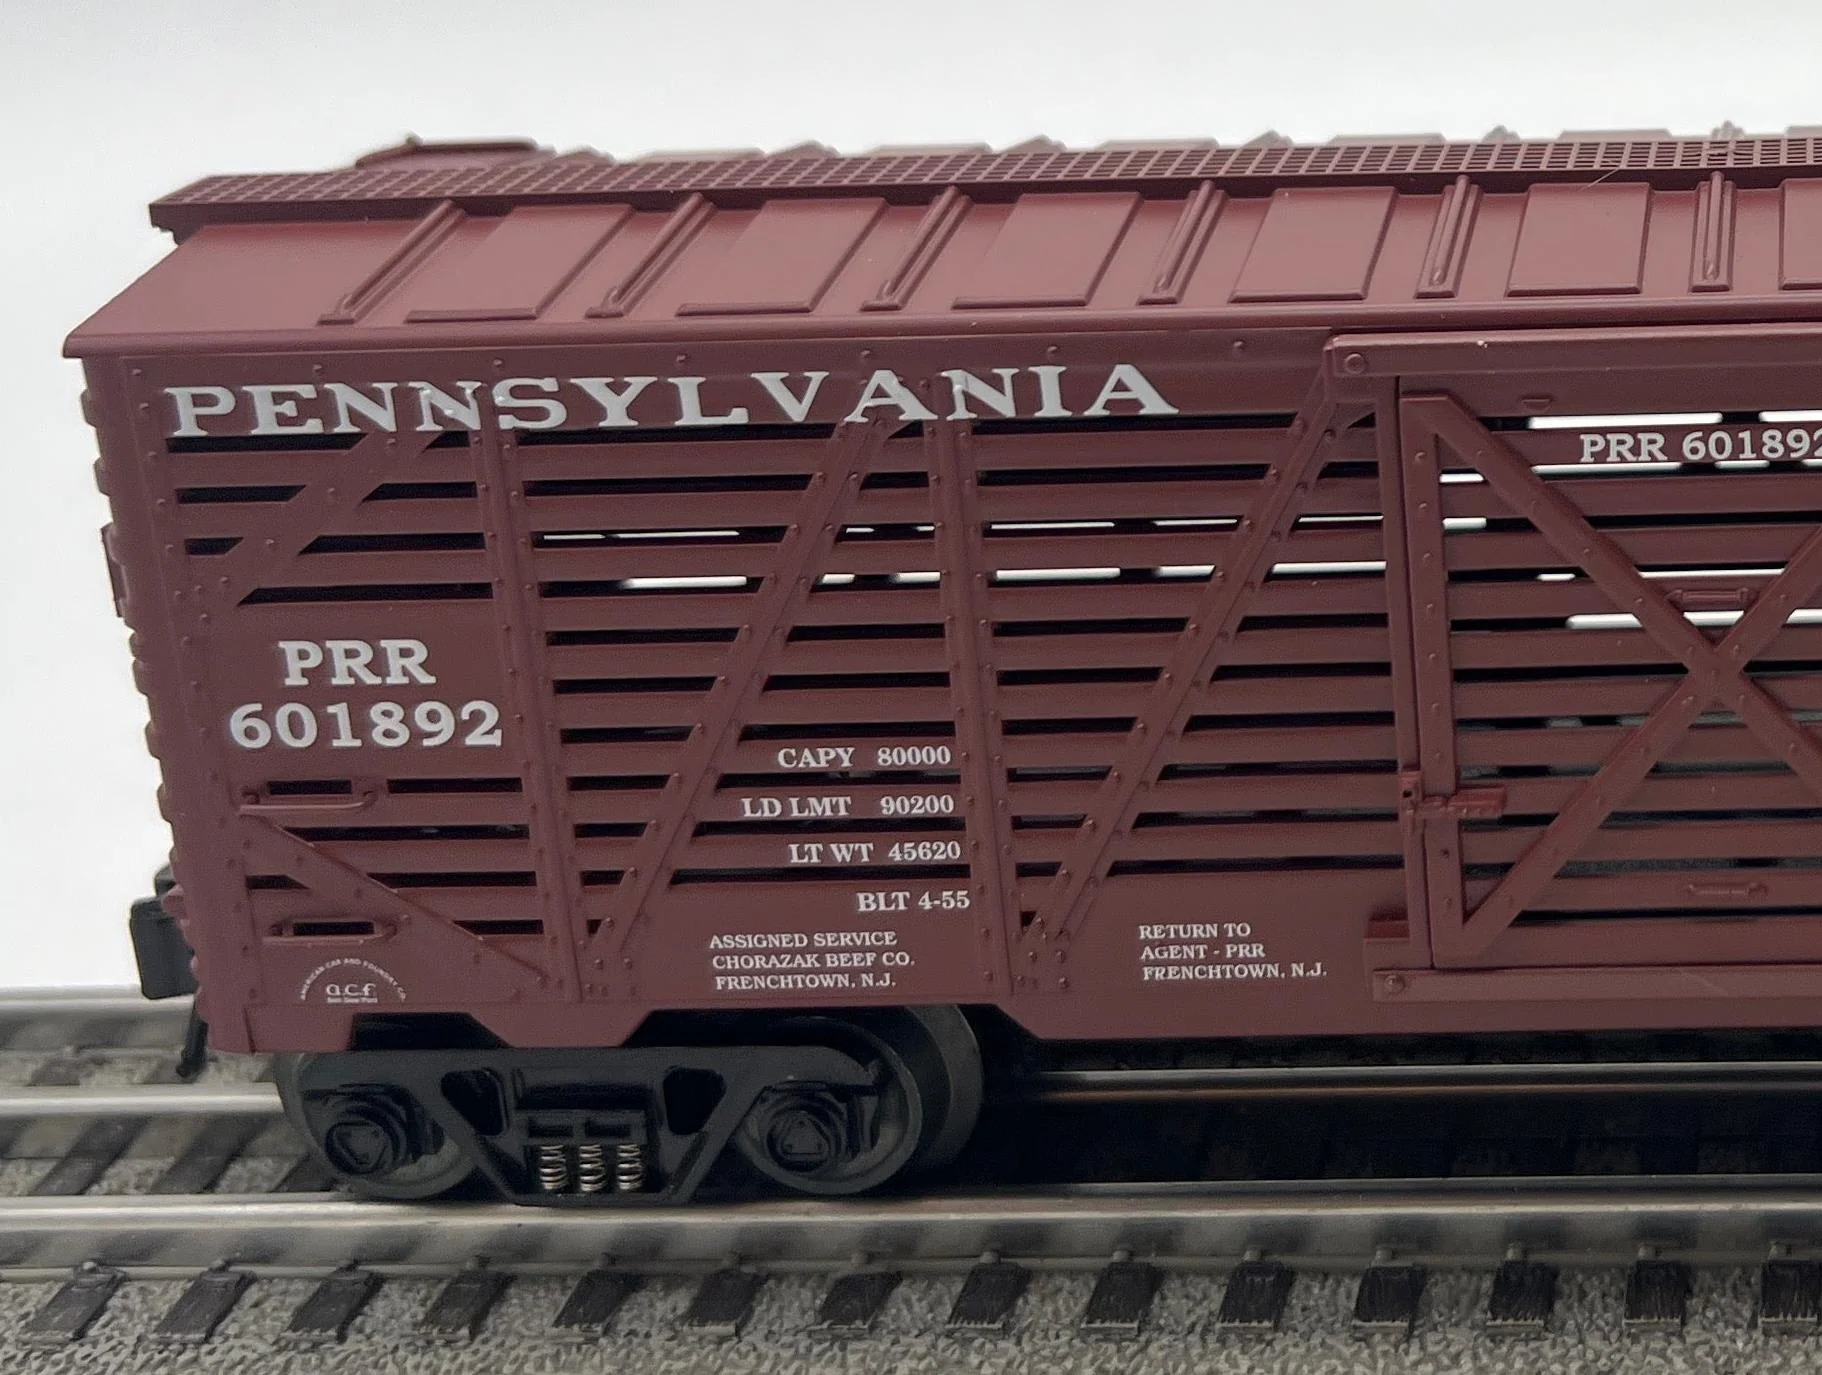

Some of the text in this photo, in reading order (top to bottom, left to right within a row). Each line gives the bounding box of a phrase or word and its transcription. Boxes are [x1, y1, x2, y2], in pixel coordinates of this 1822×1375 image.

[163, 362, 1180, 440] PENNSYLVANIA
[1579, 430, 1670, 463] PRR
[277, 638, 437, 688] PRR
[229, 699, 504, 750] 601892
[777, 744, 952, 770] CAPY 80000
[741, 793, 955, 819] LD LMT 90200
[788, 840, 962, 865] LT WT 45620
[856, 889, 971, 913] BLT 4-55
[709, 930, 898, 950] ASSIGNED SERVICE
[1139, 921, 1252, 940] RETURN TO
[712, 951, 916, 971] CHORAZAK BEEF CO.
[1140, 943, 1208, 962] AGENT
[1226, 942, 1266, 960] PRR
[861, 973, 897, 991] N.J.
[1290, 962, 1328, 980] N.J.
